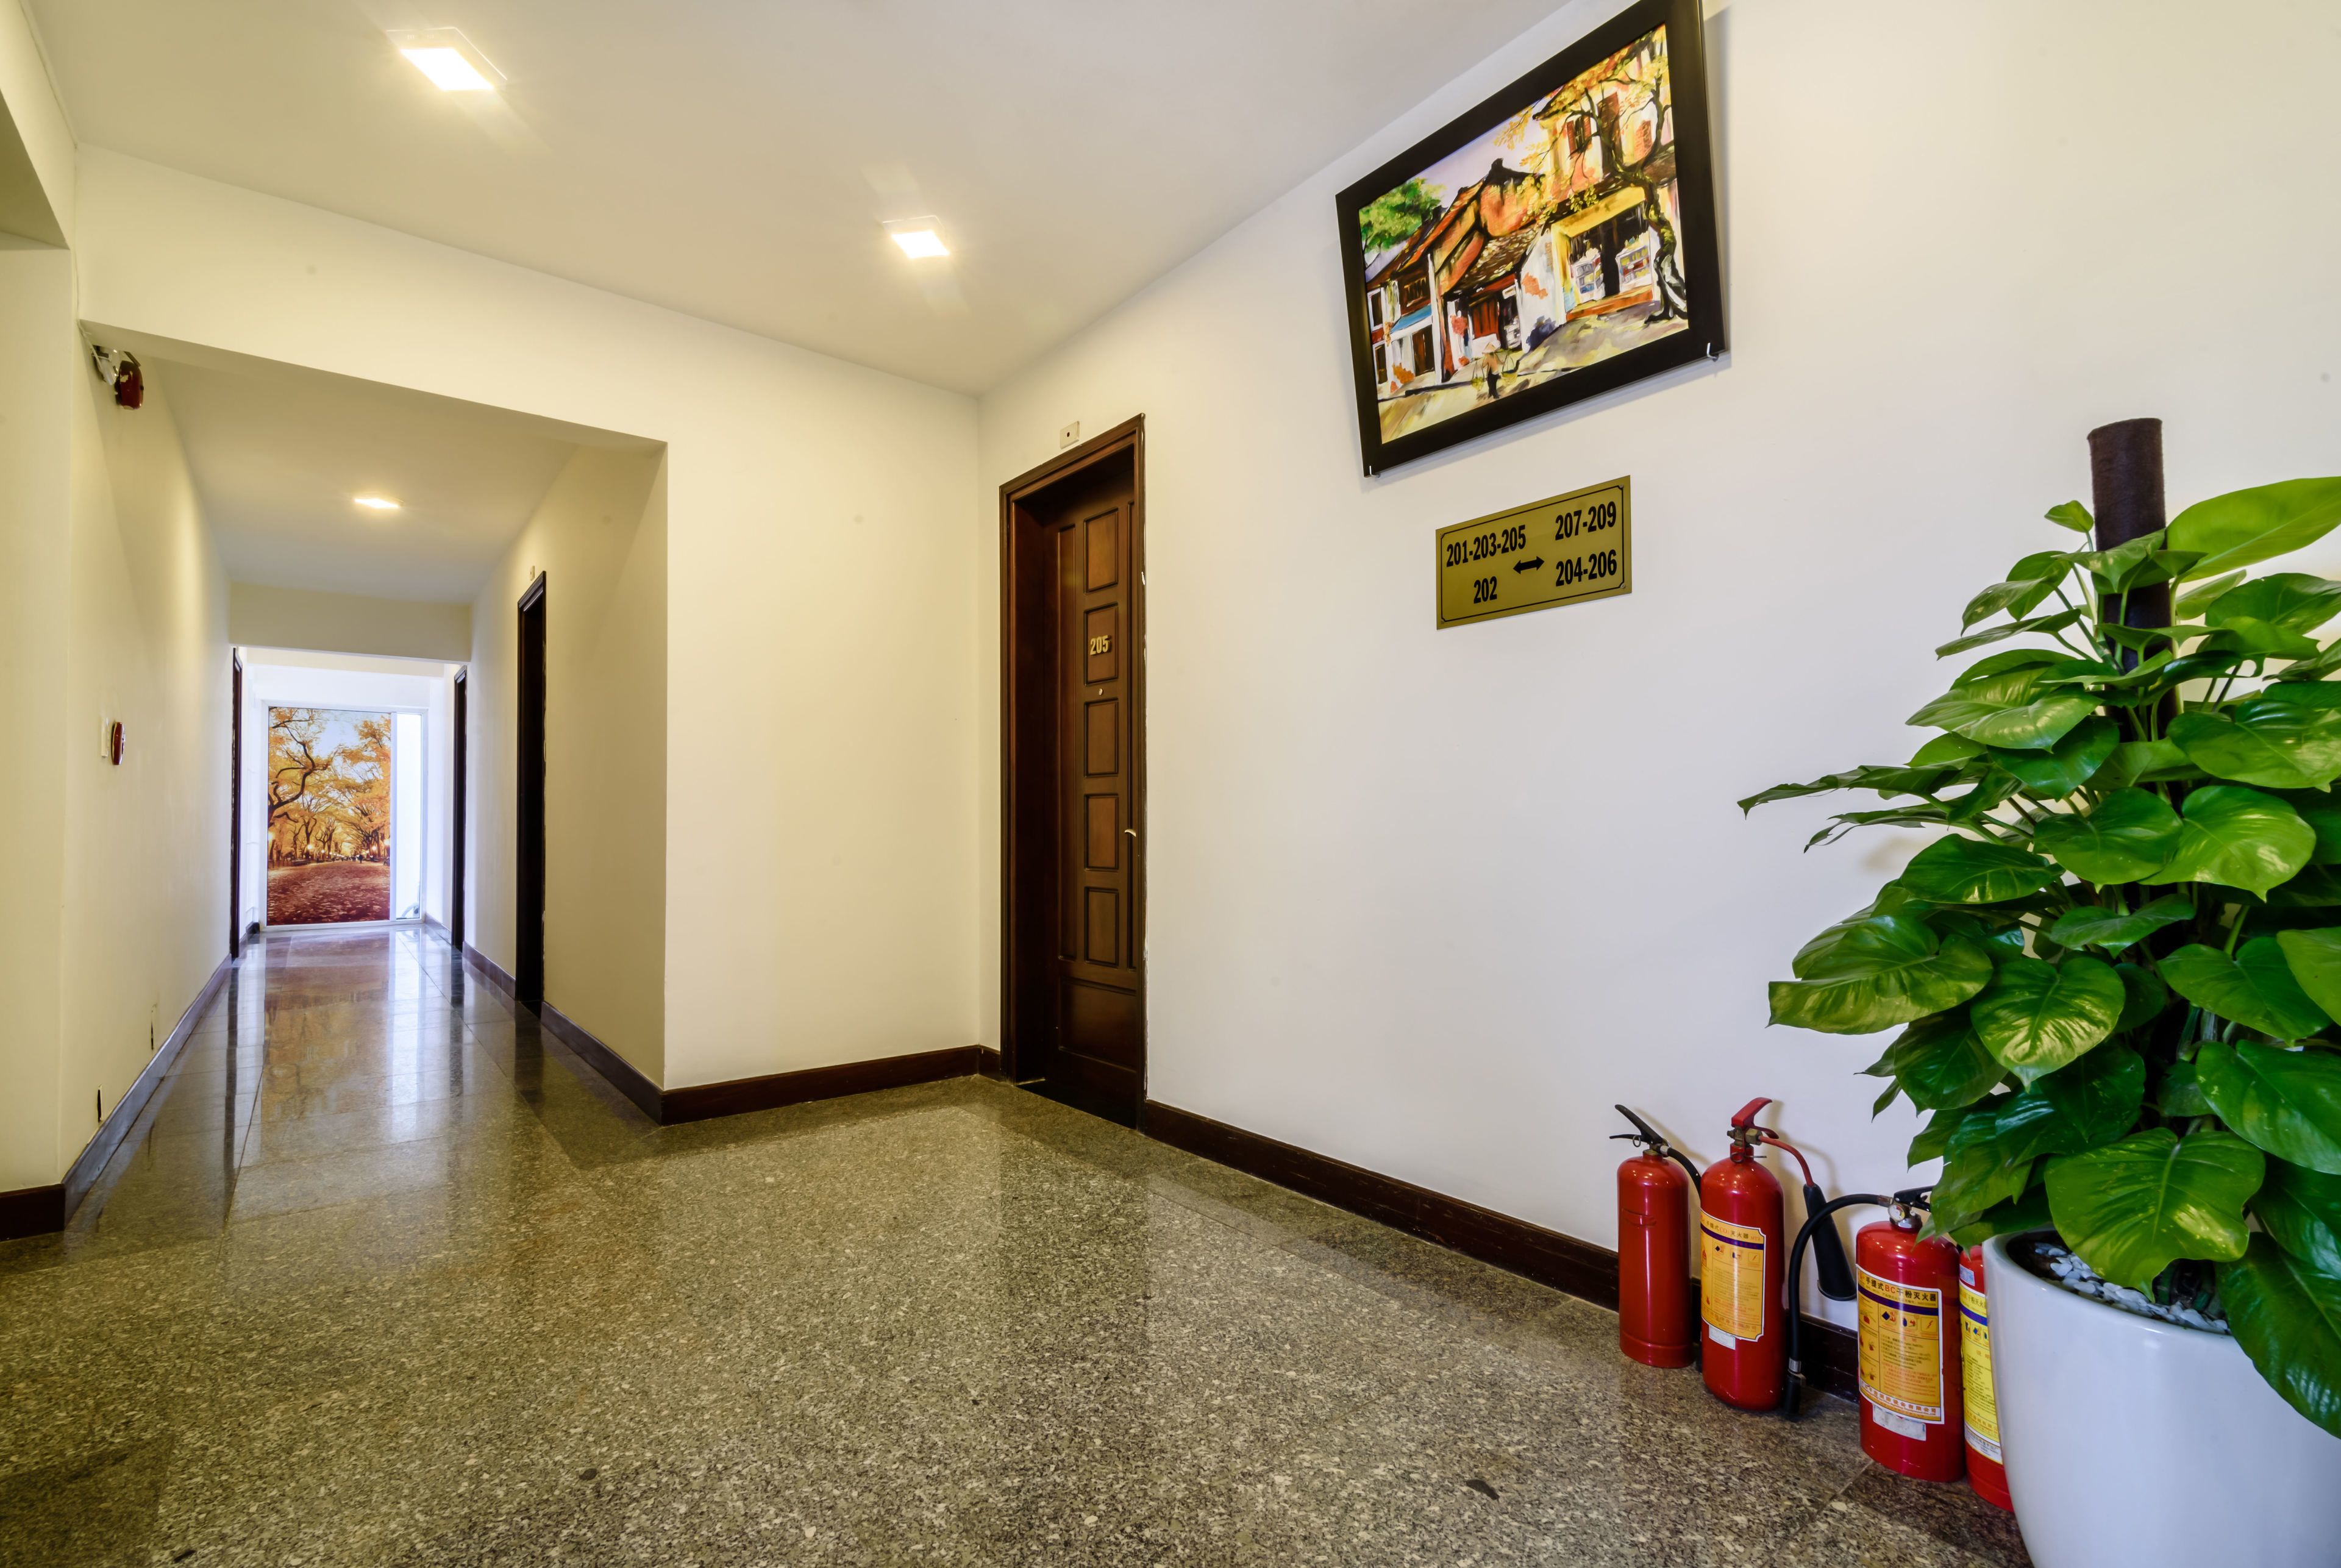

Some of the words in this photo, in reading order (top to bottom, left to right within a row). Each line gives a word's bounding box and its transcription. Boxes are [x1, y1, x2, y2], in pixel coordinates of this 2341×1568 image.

[1555, 501, 1617, 541] 207-209
[1446, 524, 1527, 568] 201-203-205
[1555, 549, 1617, 587] 204-206
[1473, 576, 1498, 604] 202
[1090, 634, 1109, 655] 205
